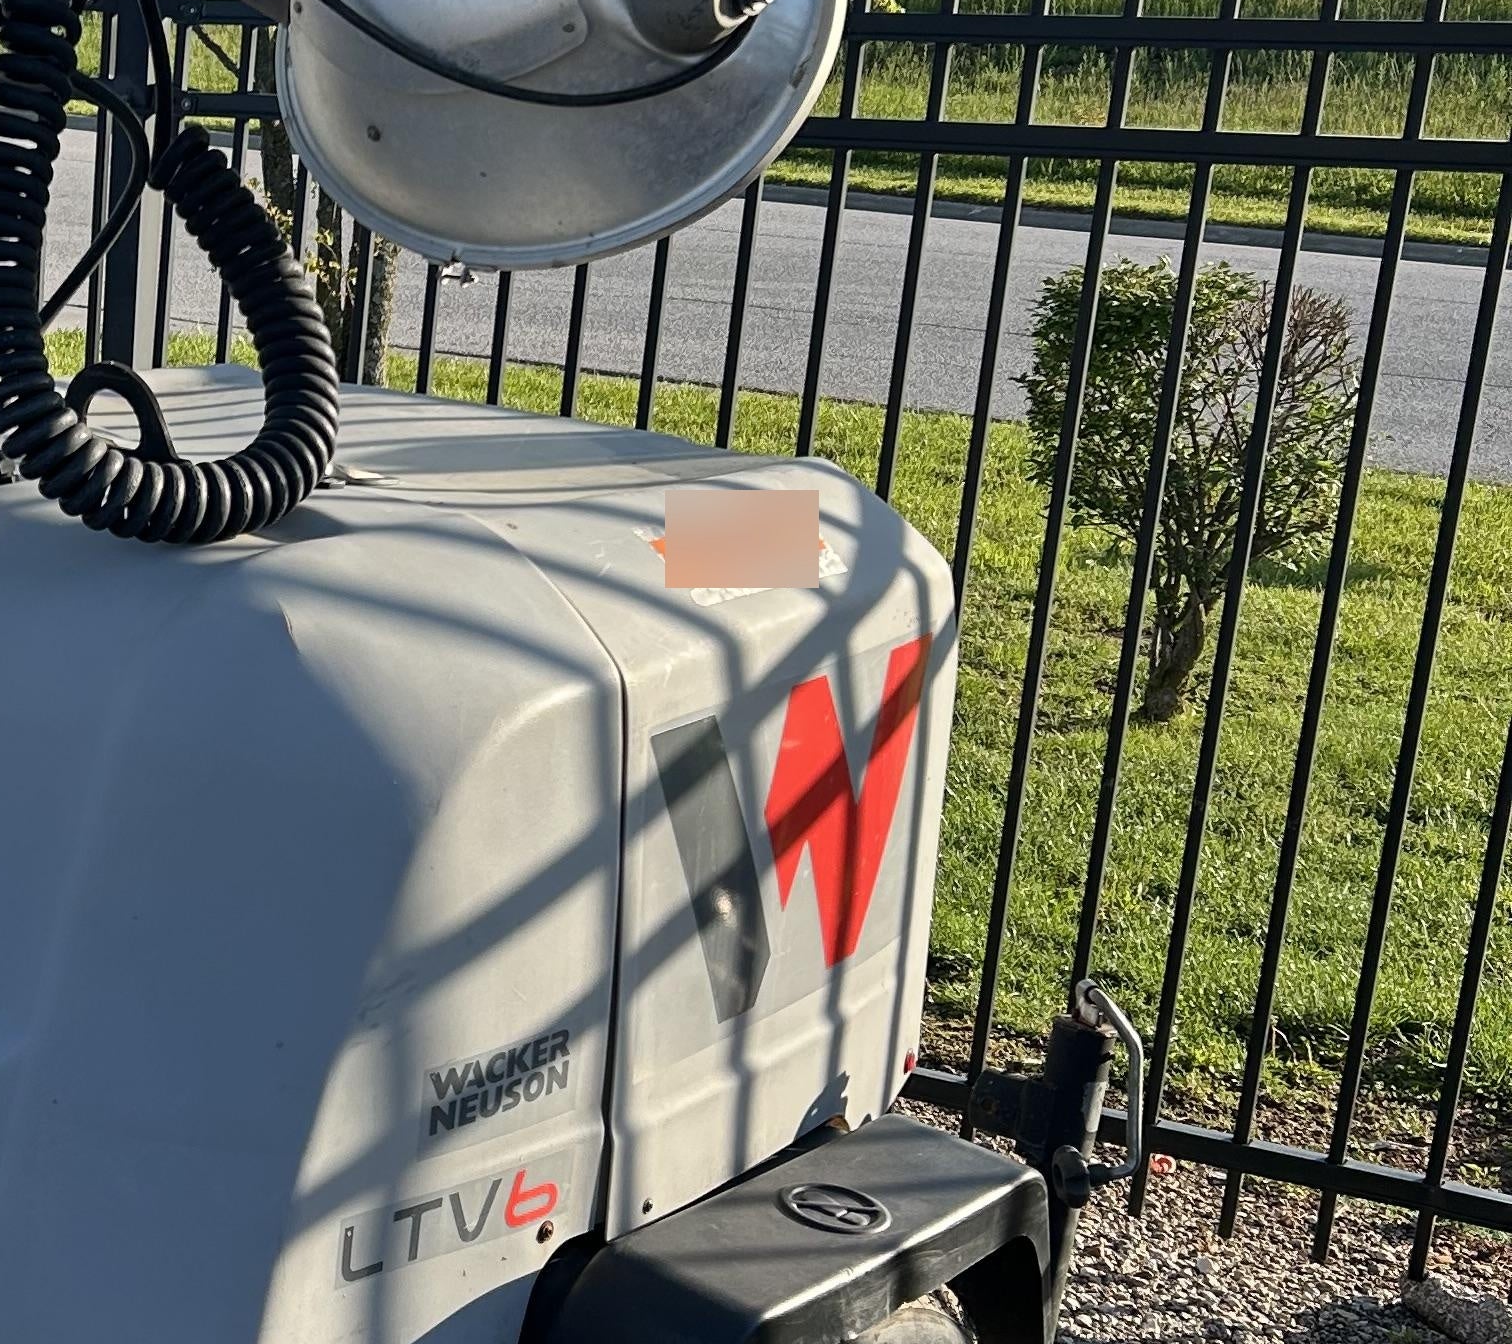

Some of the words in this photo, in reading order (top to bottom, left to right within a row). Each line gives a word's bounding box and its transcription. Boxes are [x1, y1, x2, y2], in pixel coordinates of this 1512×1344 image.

[428, 1028, 571, 1101] WACKER
[428, 1059, 570, 1137] NEUSON
[341, 1168, 559, 1283] LTV6
